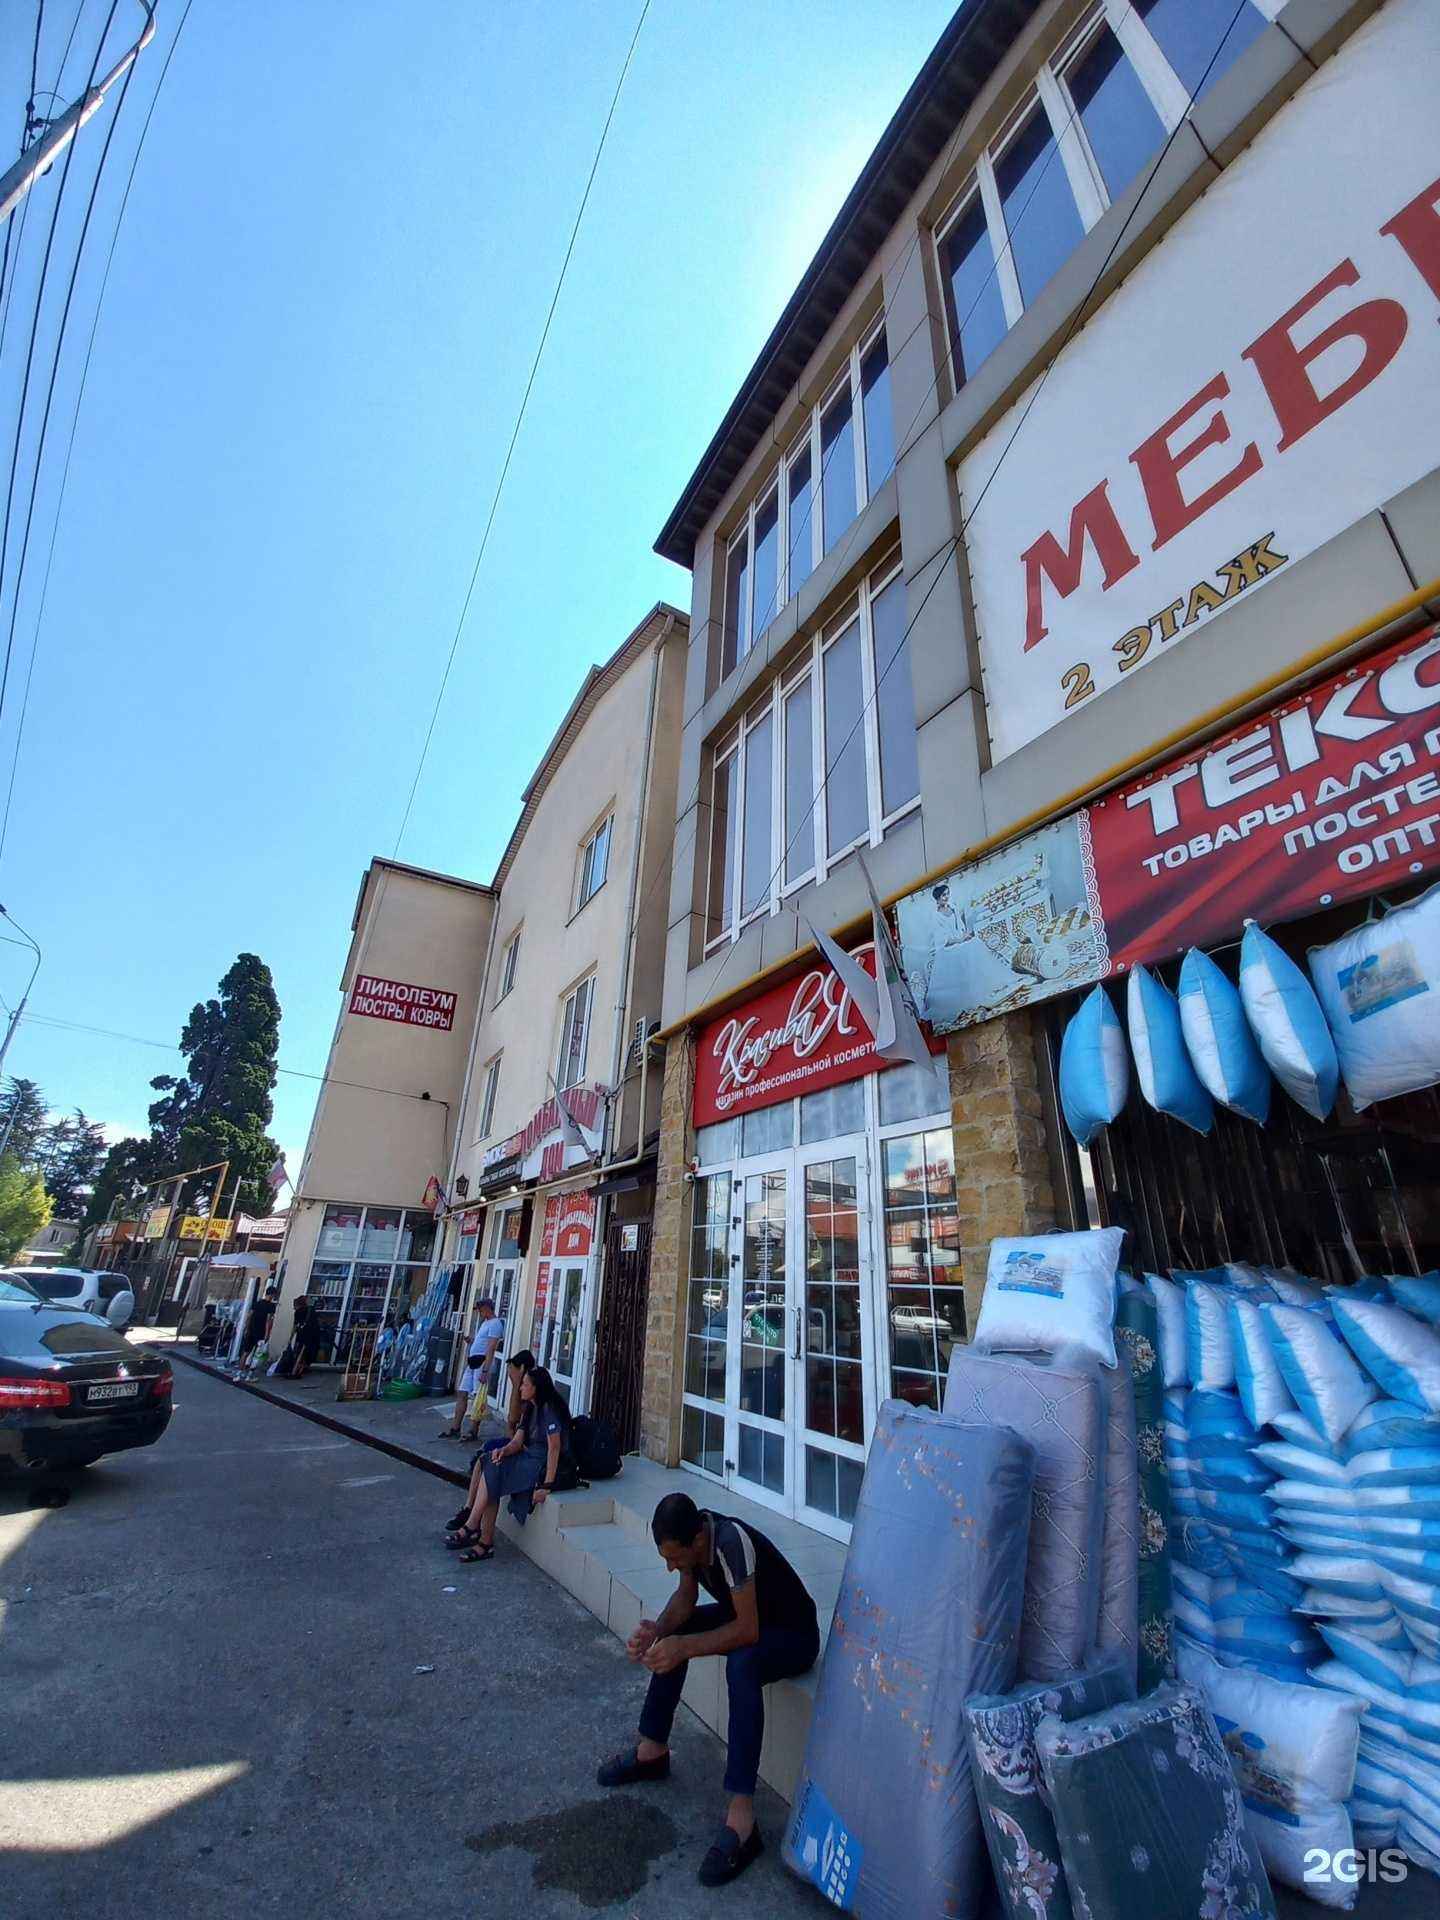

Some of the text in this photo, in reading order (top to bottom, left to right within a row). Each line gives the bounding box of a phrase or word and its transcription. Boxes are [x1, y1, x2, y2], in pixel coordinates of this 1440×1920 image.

[1060, 530, 1290, 710] 2 ЭТАЖ
[1141, 789, 1308, 878] ТОВАРЫ
[1313, 741, 1418, 806] ДЛЯ
[351, 994, 452, 1029] ЛЮСТРЫ КОВРЫ
[357, 977, 454, 1011] ЛИНОЛЕУМ
[744, 1053, 832, 1098] профессиональной
[832, 1040, 877, 1067] космети
